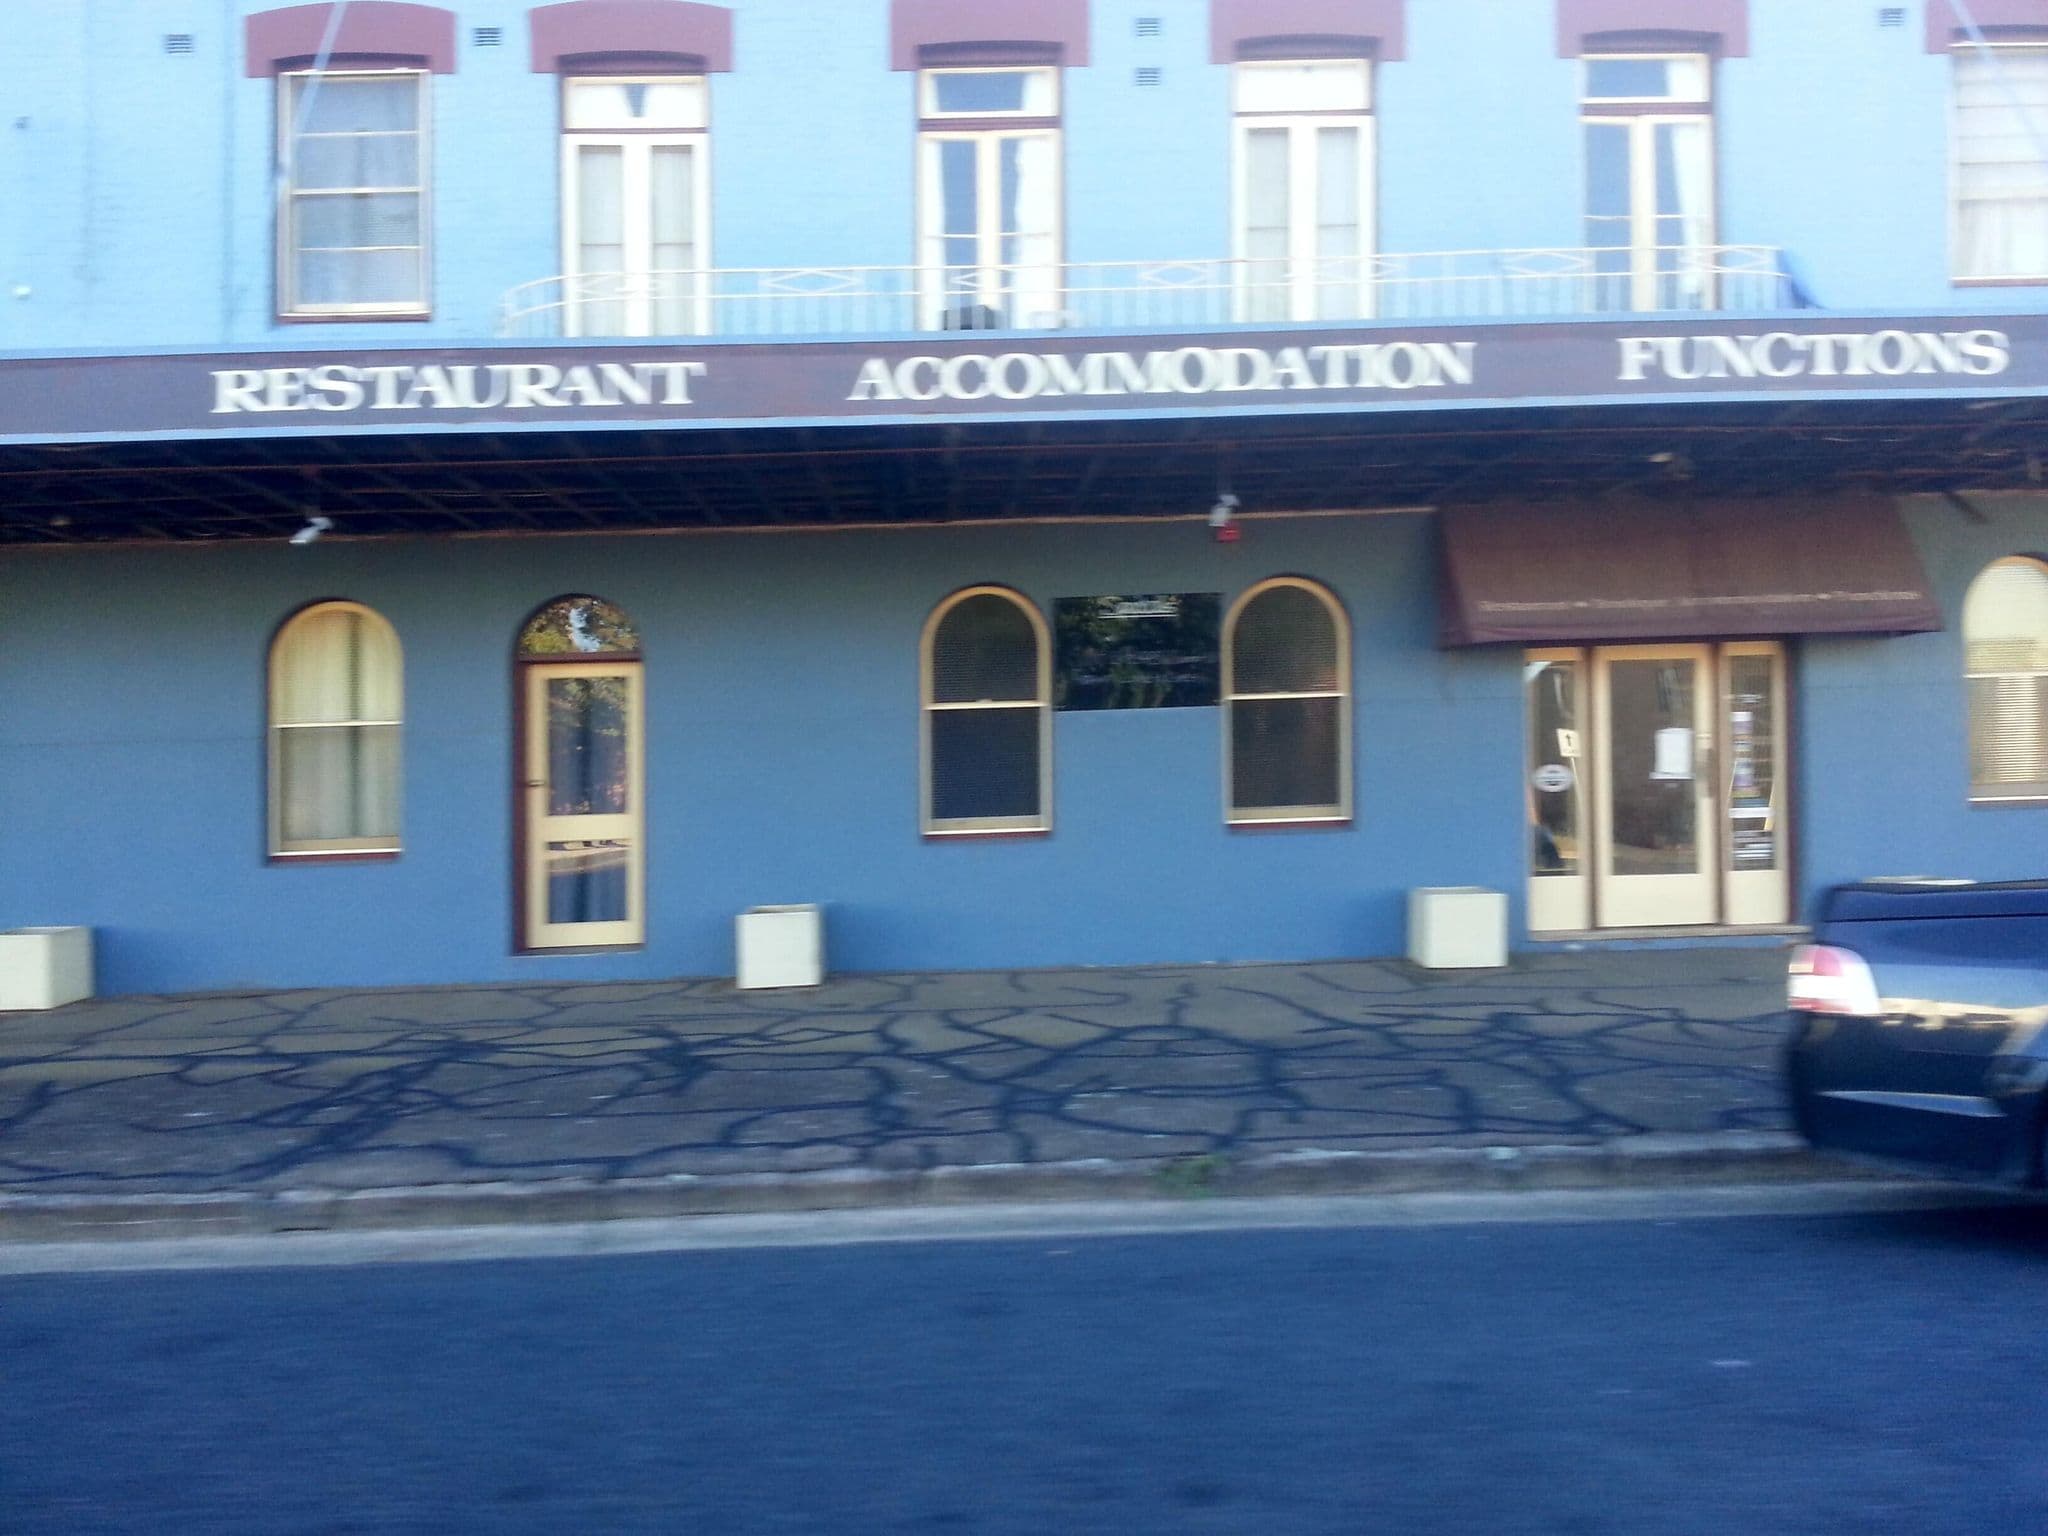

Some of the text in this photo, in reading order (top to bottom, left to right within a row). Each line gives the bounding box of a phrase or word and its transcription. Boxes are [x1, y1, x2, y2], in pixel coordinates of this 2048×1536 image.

[209, 330, 2010, 414] RESTAURANT ACCOMMODATION FUNCTIONS
